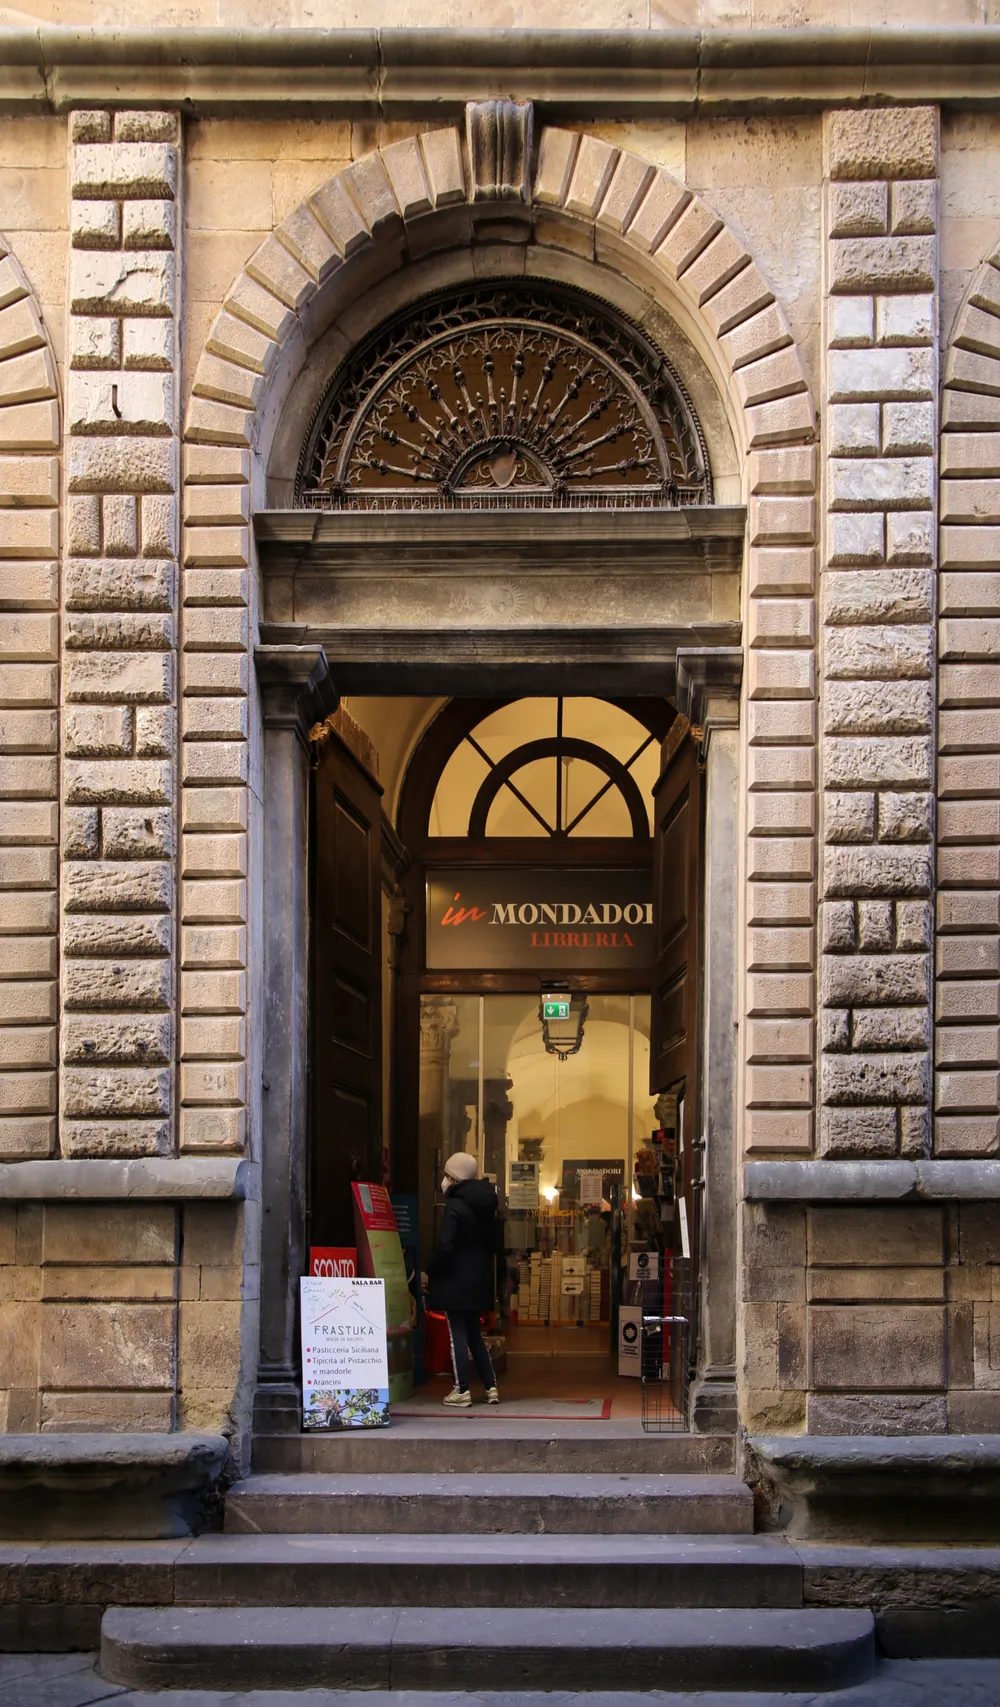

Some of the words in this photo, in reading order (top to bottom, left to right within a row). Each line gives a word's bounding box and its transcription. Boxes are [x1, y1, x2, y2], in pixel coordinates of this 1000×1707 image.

[441, 892, 487, 926] in
[530, 932, 635, 947] LIBRERIA
[313, 1258, 355, 1278] SCONTO
[314, 1326, 374, 1335] FRASTUKA
[312, 1346, 349, 1354] Pasticceria
[351, 1346, 379, 1354] Siciliana
[313, 1357, 338, 1365] Tipicità
